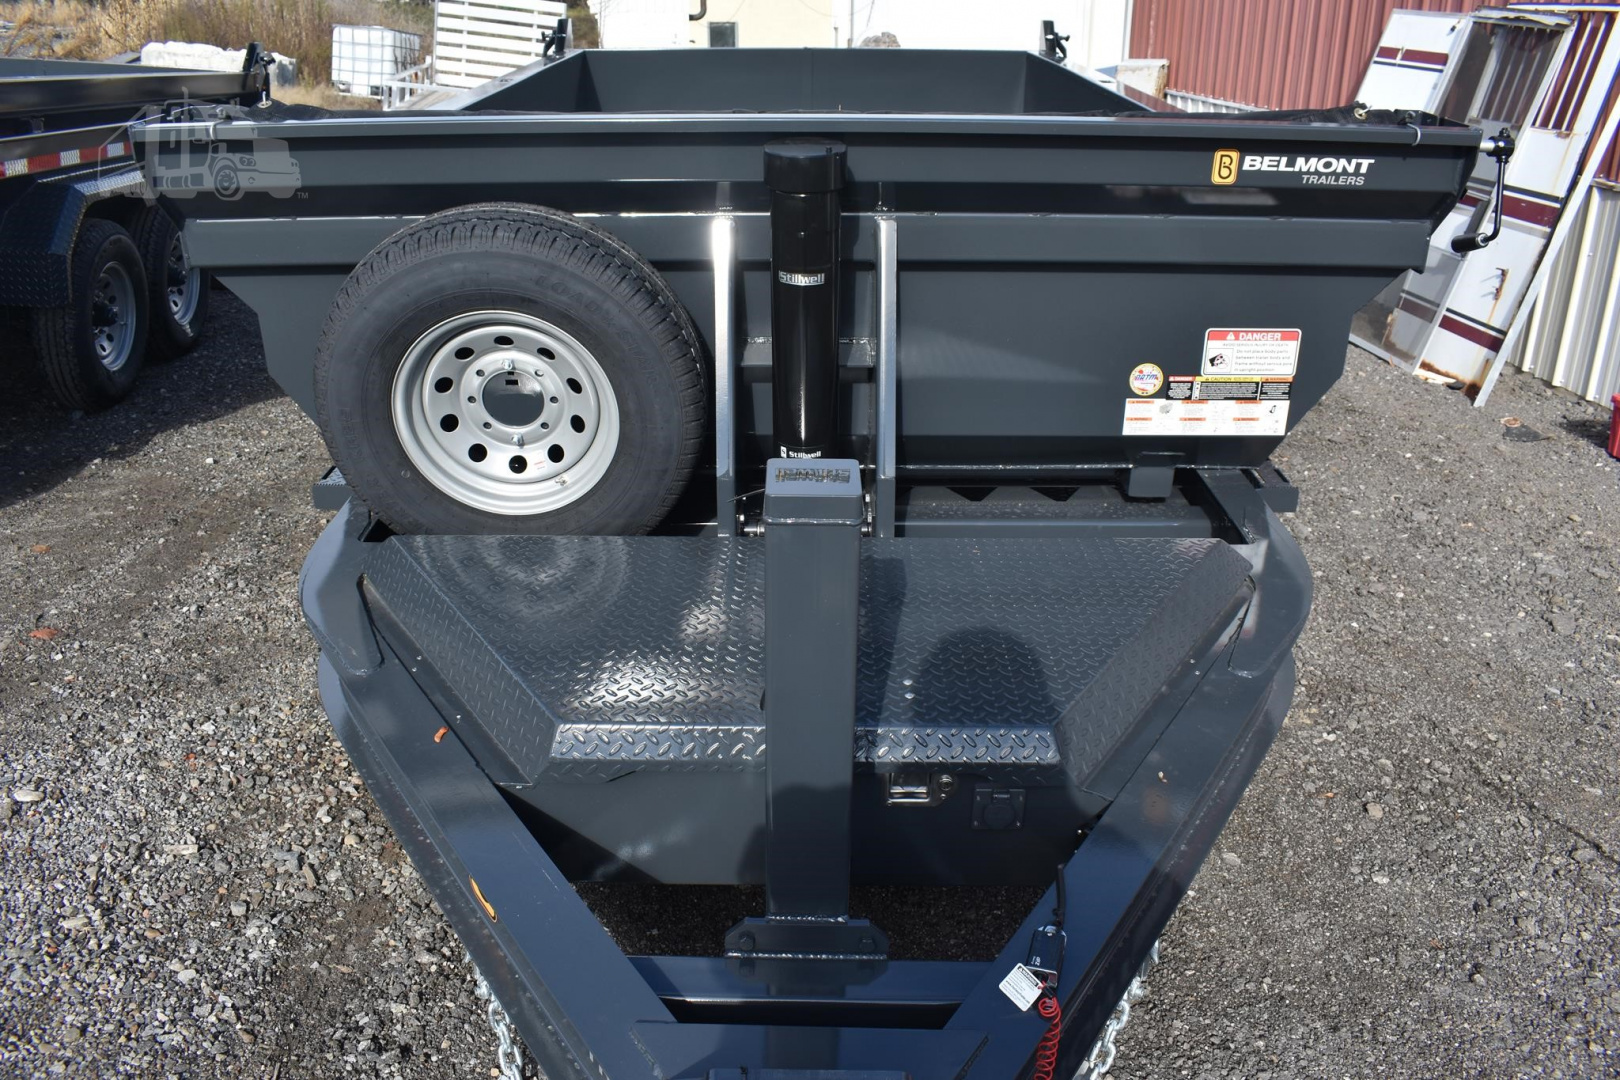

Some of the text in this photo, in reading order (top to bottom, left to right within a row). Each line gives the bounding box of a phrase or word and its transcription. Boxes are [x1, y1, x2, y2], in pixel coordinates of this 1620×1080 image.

[1242, 155, 1375, 174] BELMONT
[1302, 175, 1365, 186] TRAILERS
[779, 271, 825, 284] Stillwell
[1239, 332, 1282, 341] DANGER
[788, 450, 822, 459] Stillwell
